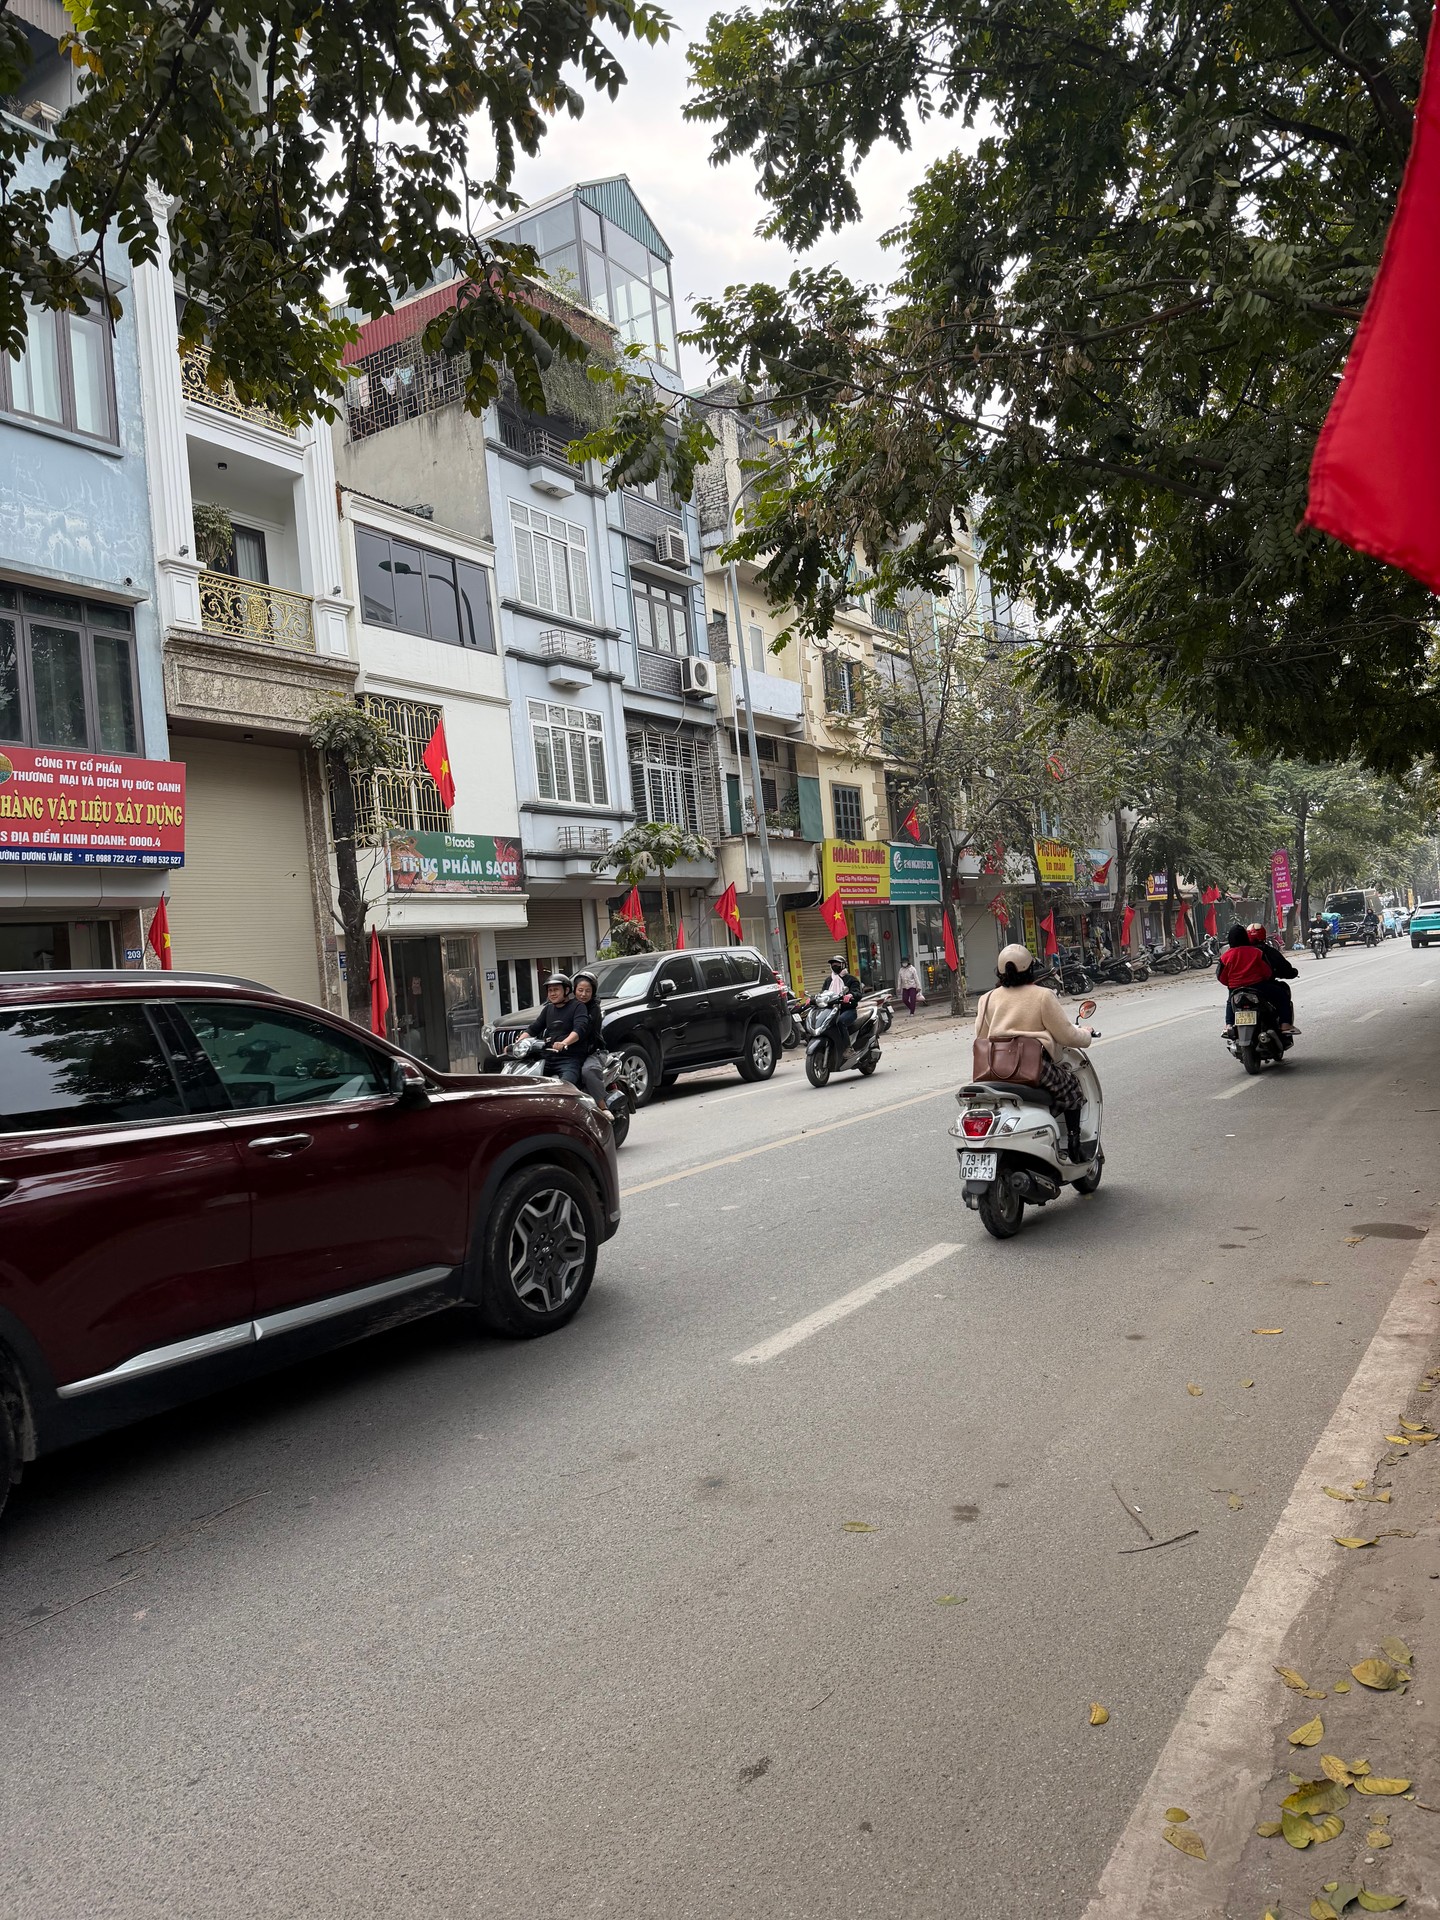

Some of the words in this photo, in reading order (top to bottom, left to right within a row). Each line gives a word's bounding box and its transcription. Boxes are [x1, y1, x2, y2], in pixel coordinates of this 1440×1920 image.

[35, 756, 63, 769] CÔNG
[66, 760, 77, 770] TY
[12, 770, 54, 784] THƯƠNG
[60, 774, 79, 787] MẠI
[82, 774, 94, 786] VÀ
[97, 777, 119, 789] DỊCH
[122, 779, 133, 792] VỤ
[136, 778, 154, 791] ĐỨC
[156, 782, 181, 793] OANH
[0, 789, 44, 820] HÀNG
[47, 792, 78, 827] VẬT
[80, 794, 112, 828] LIỆU
[115, 796, 144, 825] XÂY
[146, 802, 183, 832] DỰNG
[10, 831, 30, 844] ĐỊA
[32, 828, 60, 844] ĐIỂM
[63, 833, 88, 845] KINH
[90, 834, 127, 846] DOANH:
[130, 836, 161, 847] 0000.4
[21, 851, 46, 861] DƯƠNG
[47, 851, 62, 861] VĂN
[113, 855, 124, 863] 722
[171, 856, 181, 864] 527
[832, 844, 860, 863] HOÀNG
[485, 860, 517, 878] SẠCH
[127, 951, 141, 959] 203
